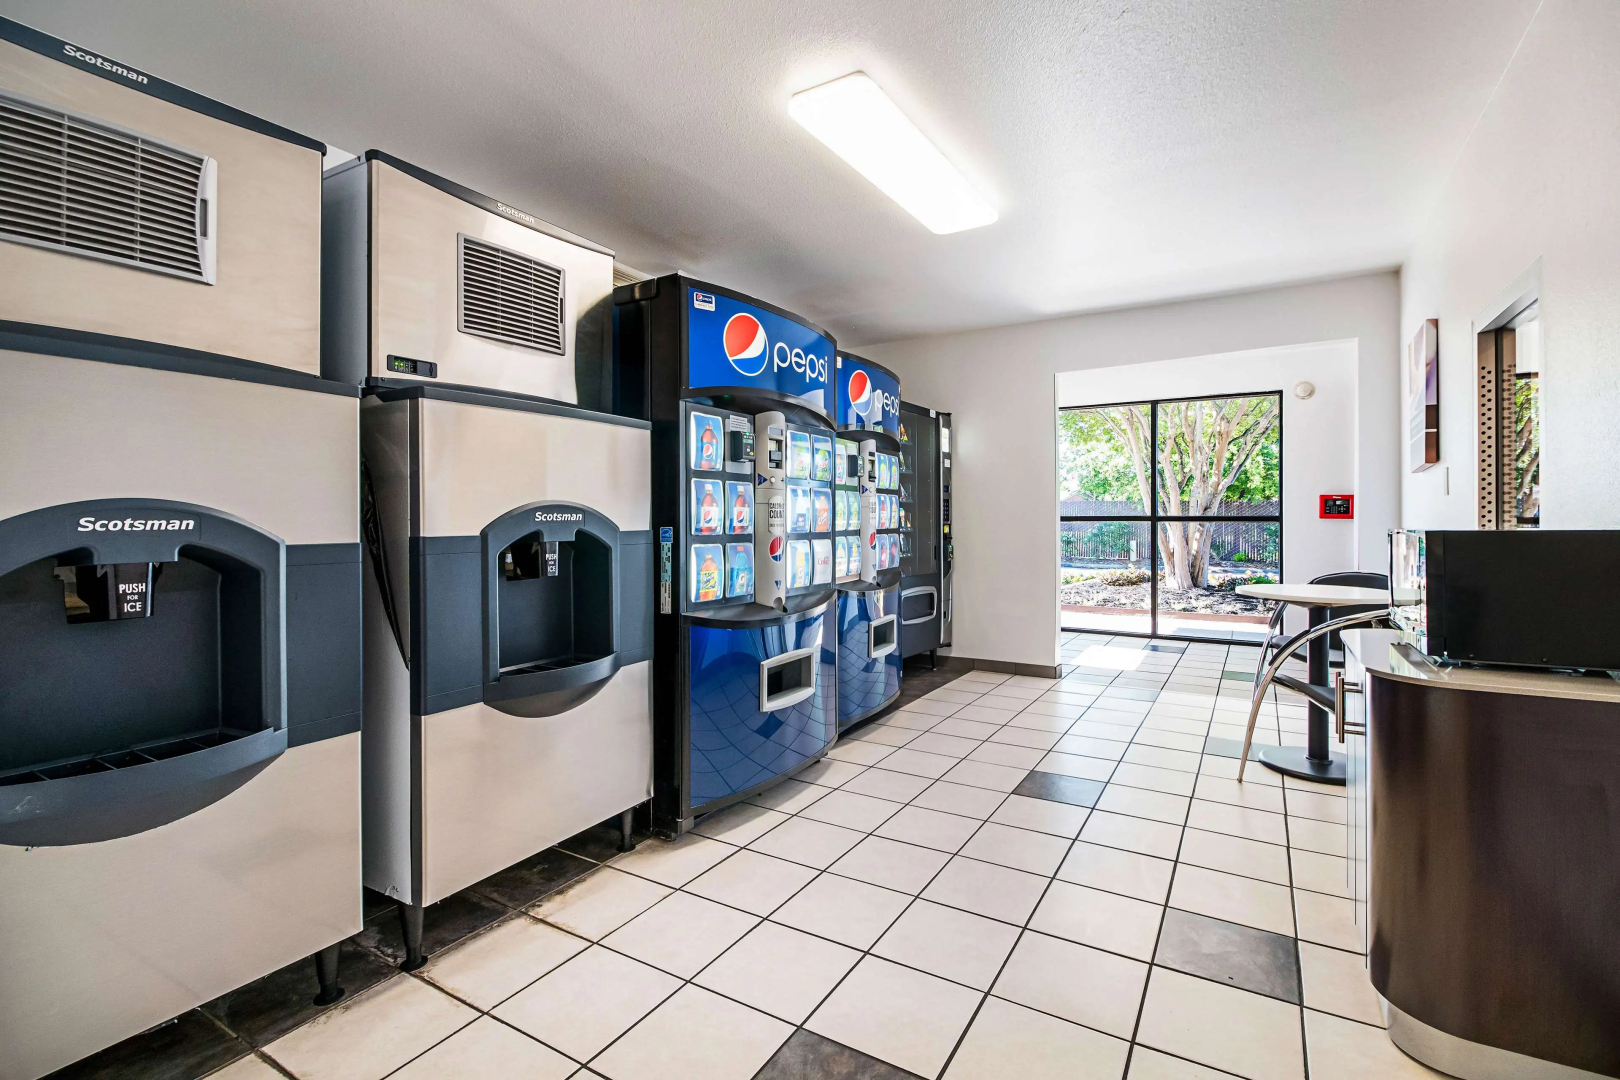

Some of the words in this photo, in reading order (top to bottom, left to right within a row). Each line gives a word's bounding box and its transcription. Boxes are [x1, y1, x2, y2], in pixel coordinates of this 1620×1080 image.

[63, 44, 149, 85] Scotsman
[496, 202, 534, 223] Scotsman
[773, 341, 828, 384] pepsi
[874, 389, 899, 417] pepsi
[77, 516, 195, 532] Scotsman
[534, 511, 583, 521] Scotsman
[545, 553, 557, 561] PUSH
[119, 582, 146, 594] PUSH
[124, 602, 142, 613] ICE
